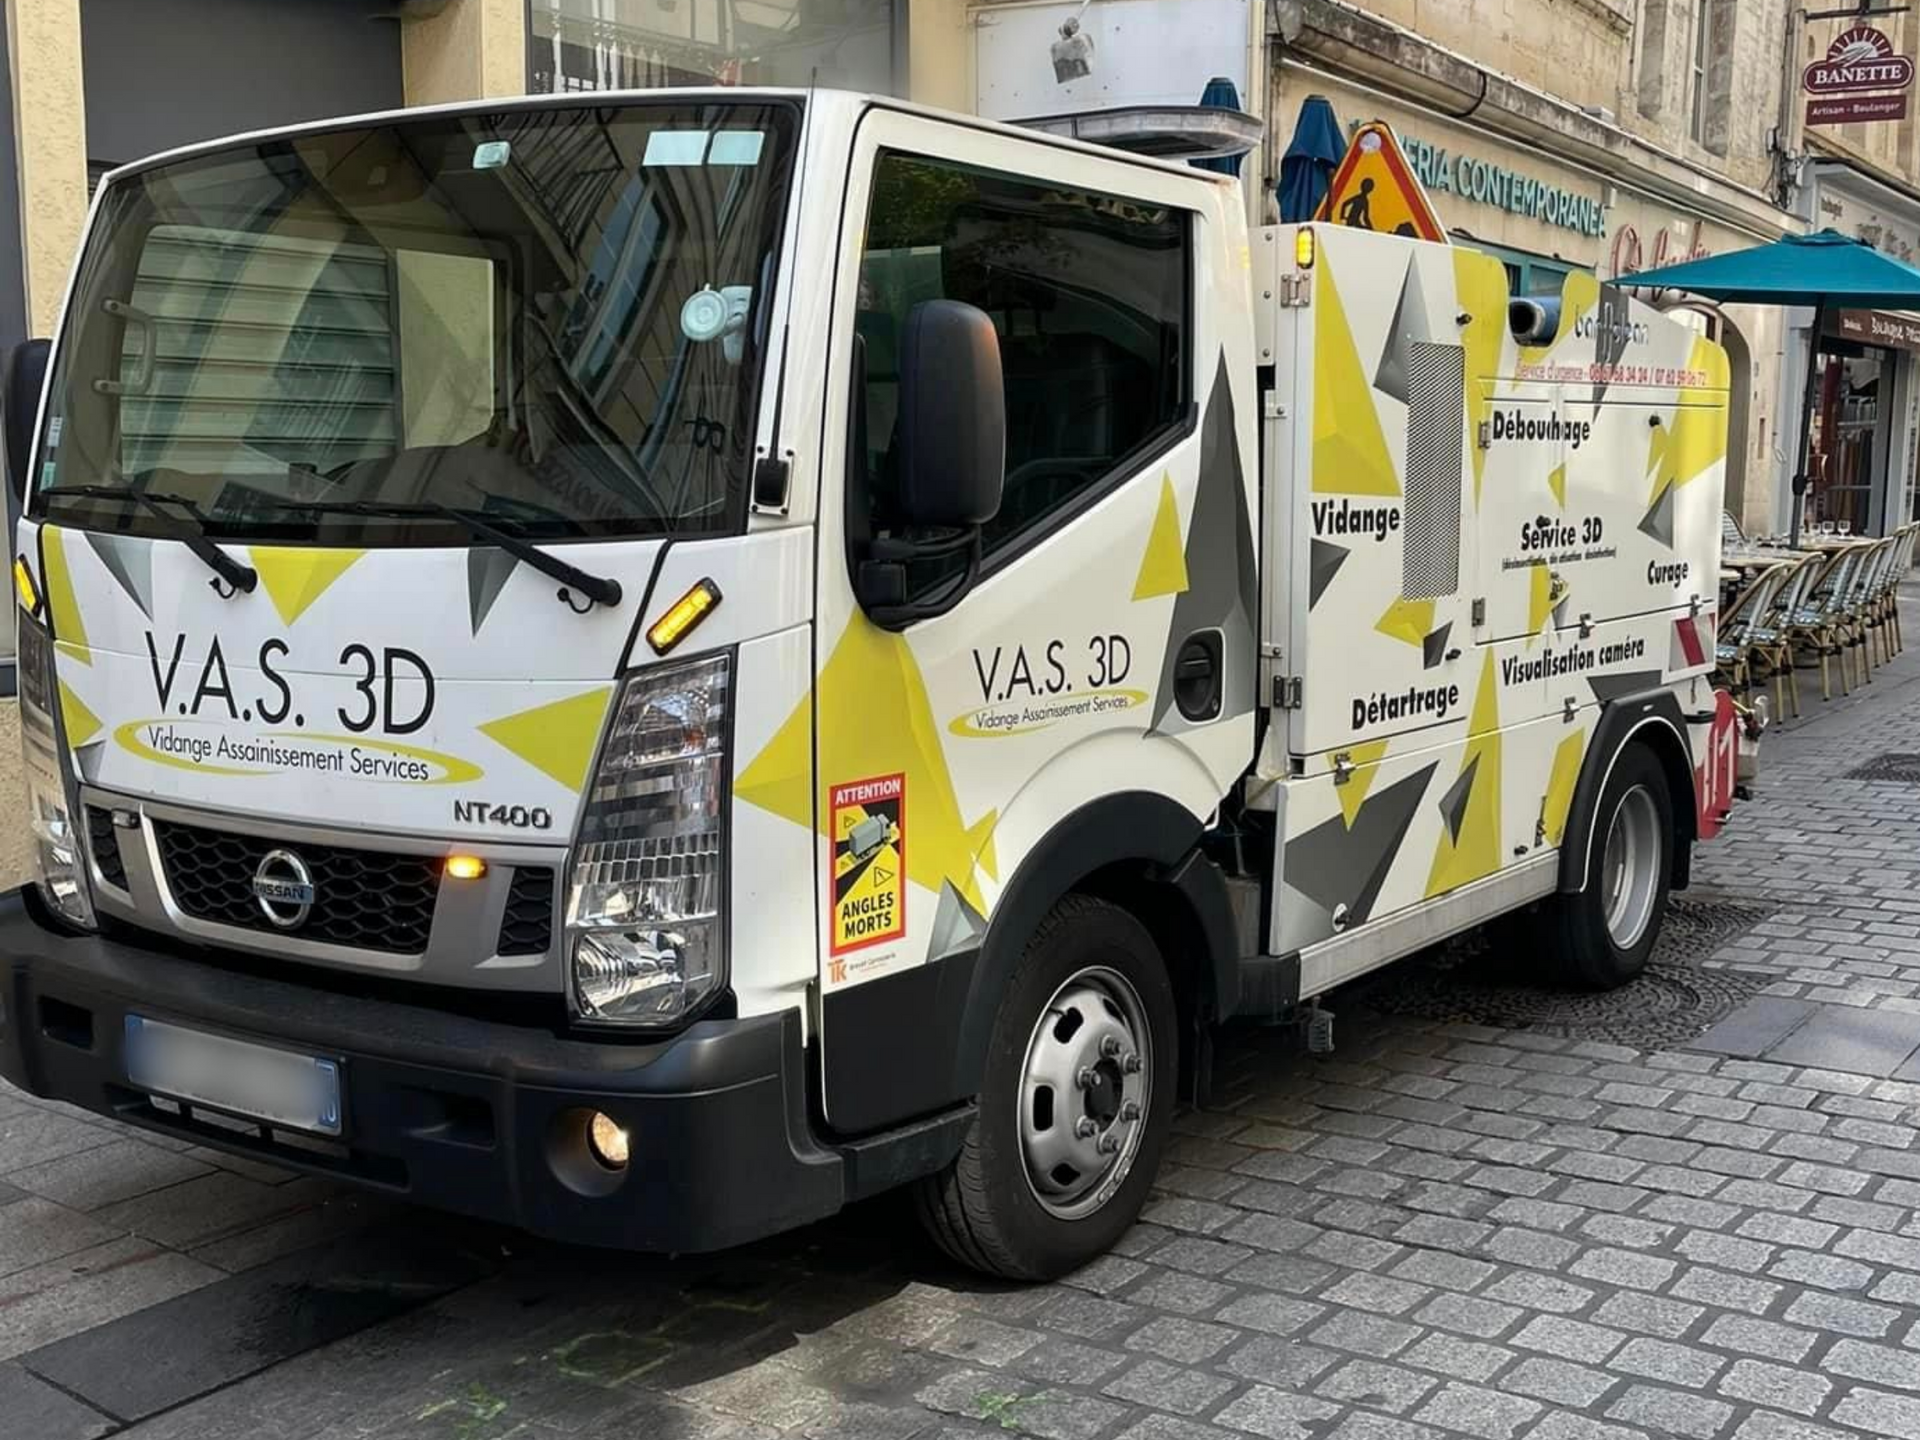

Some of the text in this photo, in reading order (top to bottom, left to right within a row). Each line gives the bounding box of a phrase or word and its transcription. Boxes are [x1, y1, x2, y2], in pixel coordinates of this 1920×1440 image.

[1814, 65, 1902, 84] BANETTE
[1812, 105, 1844, 115] Artisan
[1853, 103, 1900, 114] Boulanger
[1455, 153, 1607, 238] CONTEMPORANEA
[1493, 409, 1590, 449] Débouchage
[1312, 500, 1399, 541] Vidange
[1521, 516, 1603, 551] Service 3D
[1647, 560, 1689, 588] Curage
[973, 634, 1131, 703] V.A.S. 3D
[1502, 636, 1644, 686] Visualisation caméra
[145, 631, 435, 735] V.A.S. 3D
[976, 695, 1128, 731] Vidange Assainissement Services
[1352, 684, 1459, 730] Détartrage
[148, 725, 430, 782] Vidange Assainissement Services
[835, 778, 901, 806] ATTENTION
[454, 800, 552, 829] NT400
[254, 881, 305, 900] NISSAN
[842, 891, 893, 920] ANGLES
[845, 910, 892, 939] MORTS
